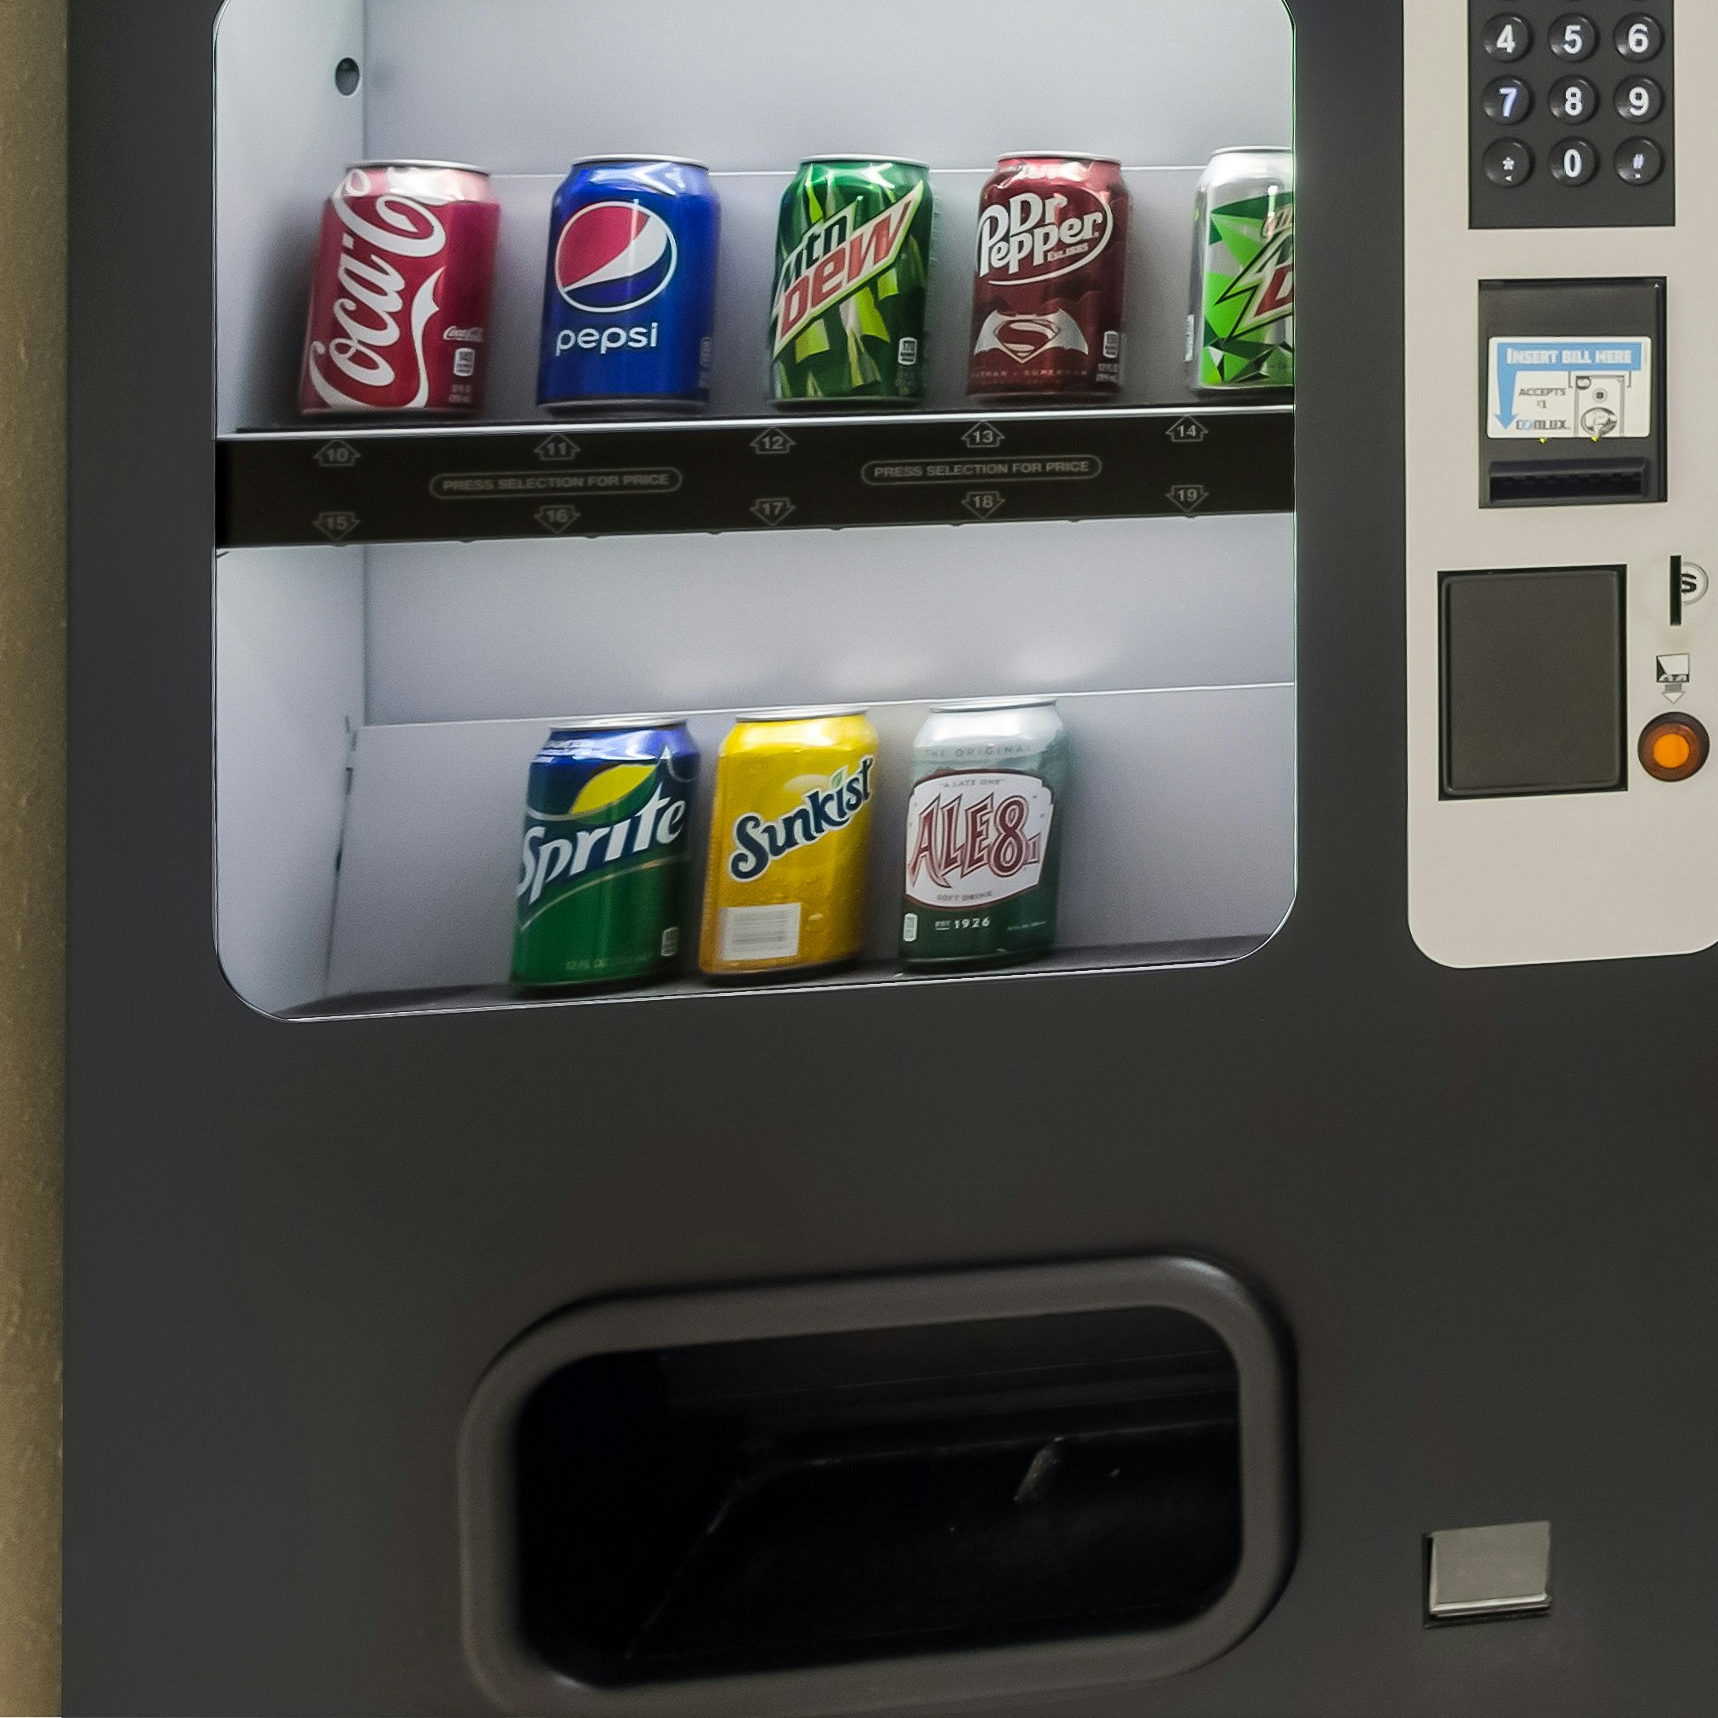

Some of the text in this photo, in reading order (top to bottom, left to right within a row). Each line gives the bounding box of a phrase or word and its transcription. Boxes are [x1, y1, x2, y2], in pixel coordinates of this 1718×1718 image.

[1496, 24, 1515, 54] 4
[1563, 24, 1583, 54] 5
[1627, 23, 1649, 53] 6
[1499, 86, 1517, 117] 7
[1564, 86, 1583, 116] 8
[1628, 86, 1649, 117] 9
[1563, 148, 1582, 178] 0
[1009, 192, 1068, 234] Dr
[978, 204, 1103, 278] Pepper
[555, 322, 659, 356] pepsi
[1506, 347, 1632, 365] INSERT BILL HERE
[973, 431, 993, 443] 13
[1176, 424, 1198, 438] 14
[546, 443, 567, 456] 11
[762, 436, 784, 451] 12
[328, 448, 349, 463] 10
[874, 461, 1089, 478] PRESS SELECTION FOR PRICE
[443, 474, 669, 491] PRESS SELECTION FOR PRICE
[973, 495, 993, 508] 18
[1177, 488, 1198, 502] 19
[547, 509, 568, 523] 16
[762, 501, 784, 515] 17
[328, 516, 349, 530] 15
[730, 755, 875, 881] Sunkist
[516, 782, 686, 906] Sprite
[954, 917, 990, 929] 1926
